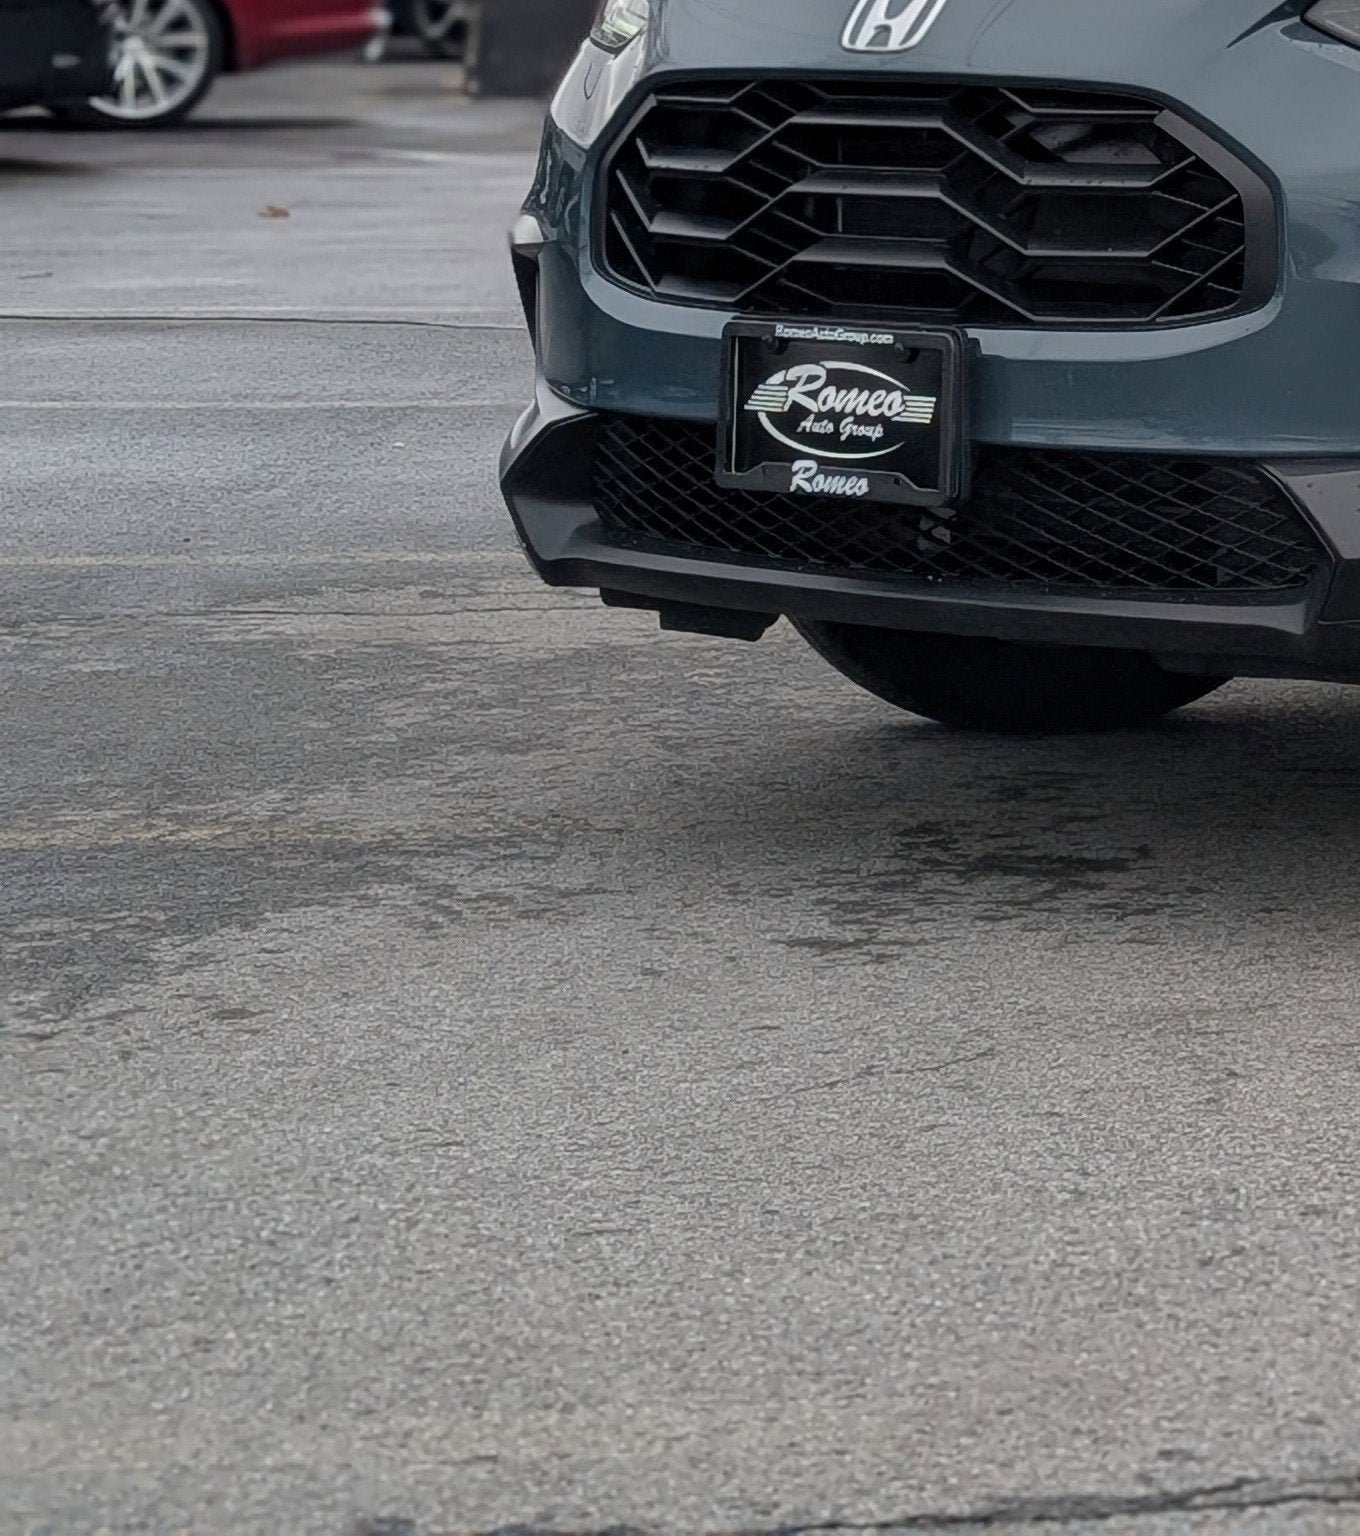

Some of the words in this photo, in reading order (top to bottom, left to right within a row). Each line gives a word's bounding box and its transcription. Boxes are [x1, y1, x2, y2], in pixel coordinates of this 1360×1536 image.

[783, 364, 906, 416] Romeo
[796, 414, 835, 434] Auto
[839, 416, 884, 442] Group
[790, 460, 870, 496] Romeo
